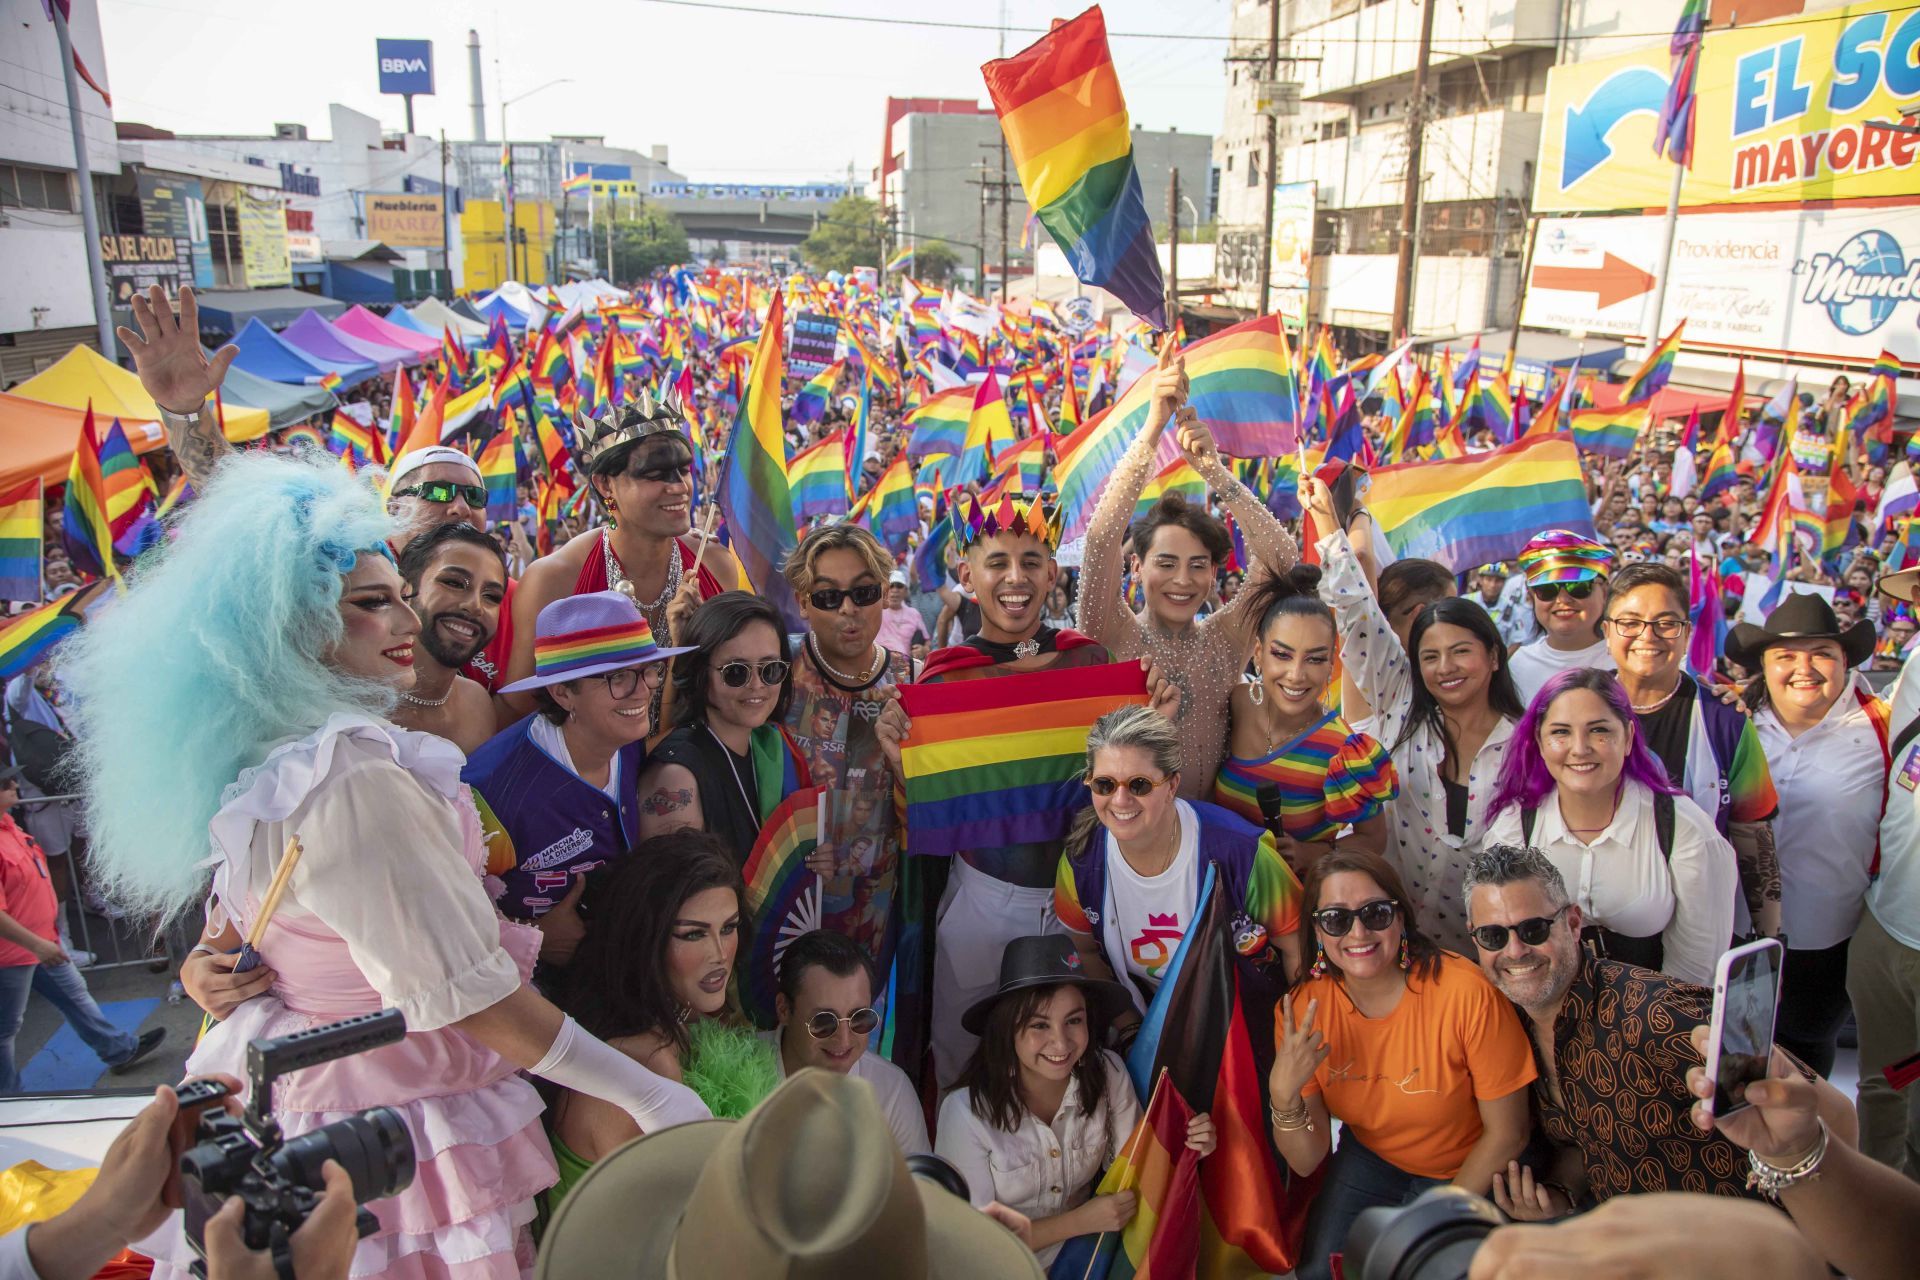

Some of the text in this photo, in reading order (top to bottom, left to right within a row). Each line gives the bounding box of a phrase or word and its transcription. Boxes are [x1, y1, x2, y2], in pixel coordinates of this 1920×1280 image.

[382, 58, 427, 73] BBVA
[1733, 36, 1812, 138] EL
[120, 236, 140, 261] DEL
[1677, 239, 1780, 259] Providencia
[795, 319, 837, 336] SER
[793, 337, 835, 350] ESTAR
[542, 836, 574, 858] MARCHA
[543, 855, 554, 863] LA
